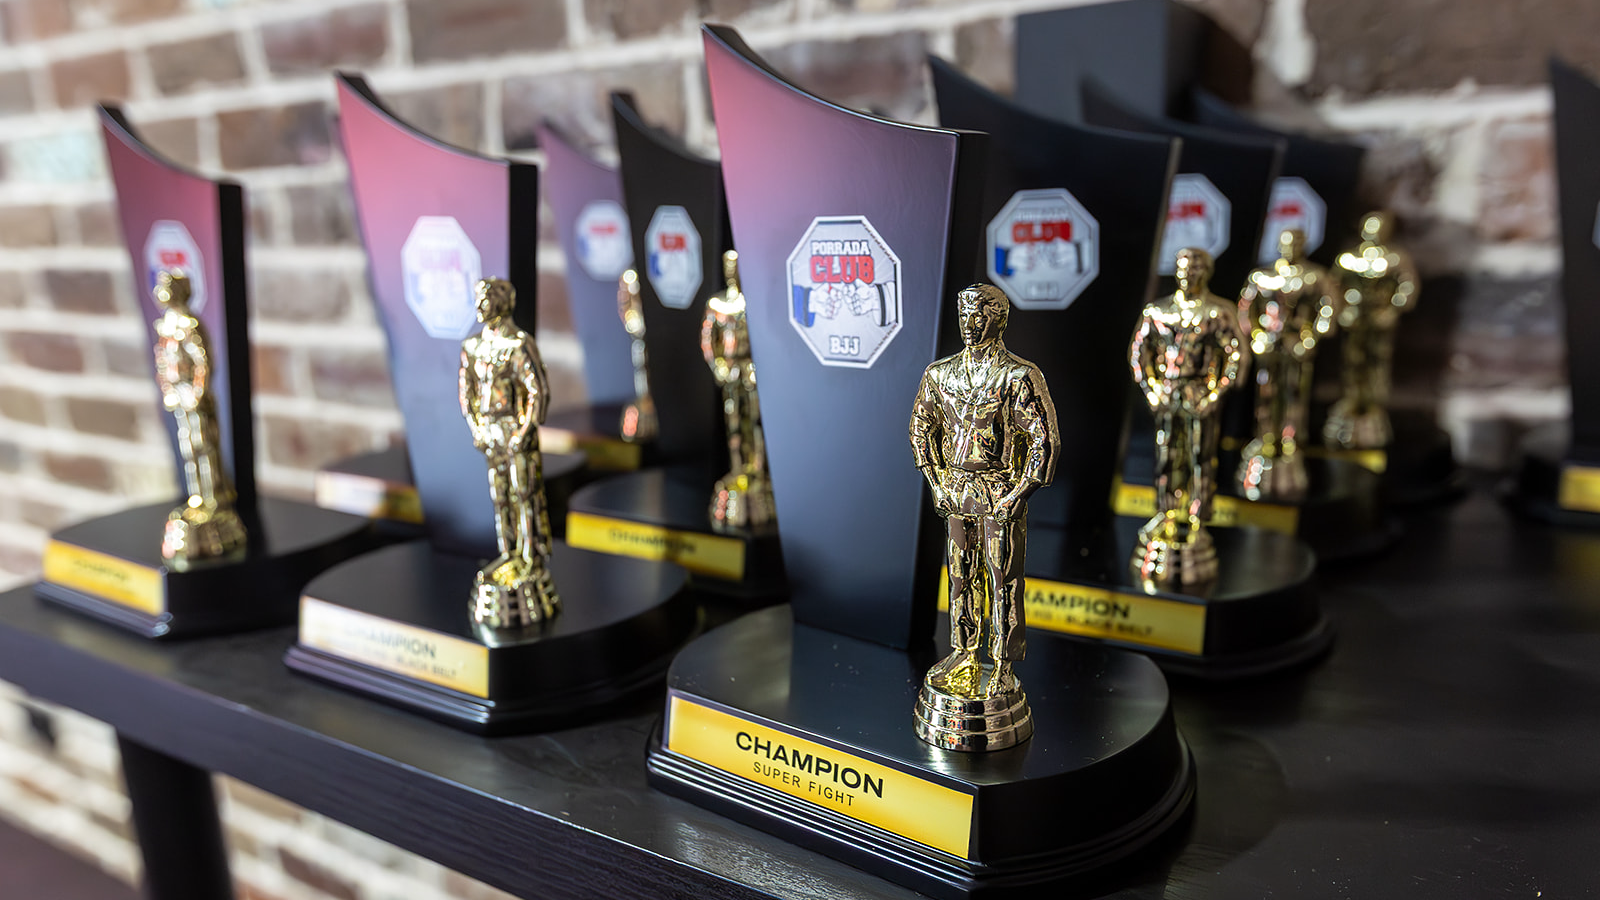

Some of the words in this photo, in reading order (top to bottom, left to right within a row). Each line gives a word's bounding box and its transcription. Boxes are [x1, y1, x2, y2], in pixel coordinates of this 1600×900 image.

[811, 240, 872, 256] PORRADA
[810, 255, 875, 284] CLUB
[829, 335, 860, 355] BJJ
[1025, 591, 1130, 618] AMPION
[736, 732, 883, 798] CHAMPION
[753, 761, 801, 788] SUPER
[809, 782, 855, 806] FIGHT
